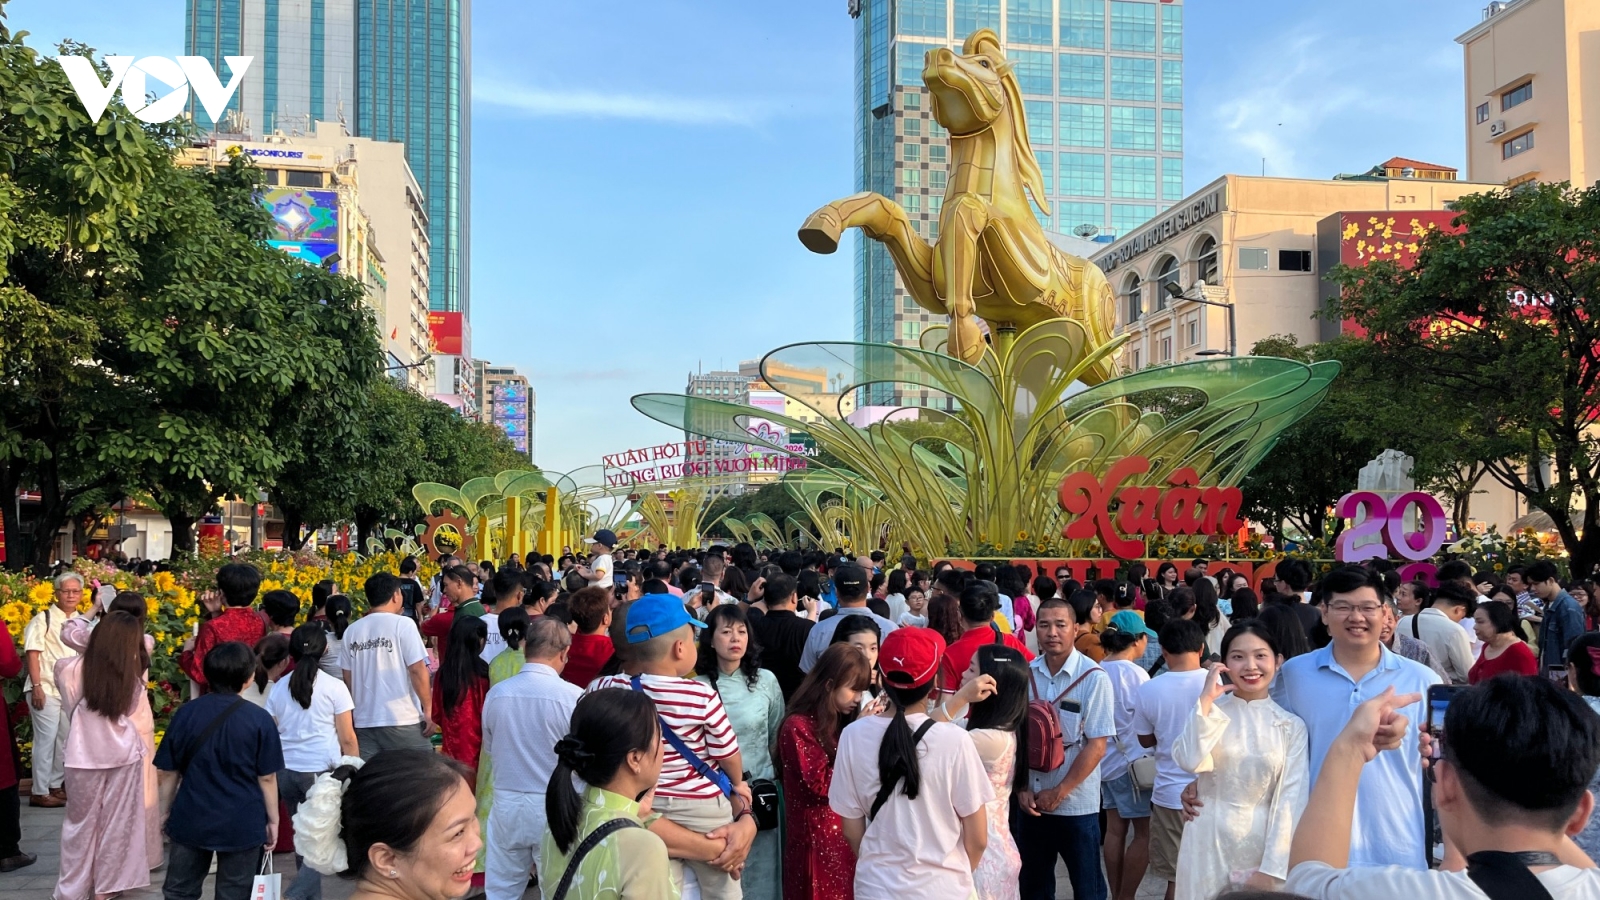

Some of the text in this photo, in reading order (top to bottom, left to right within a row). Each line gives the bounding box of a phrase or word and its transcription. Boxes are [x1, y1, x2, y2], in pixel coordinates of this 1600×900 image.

[1148, 217, 1178, 248] HOTEL
[1176, 193, 1218, 231] SAIGON
[603, 449, 649, 470] XUÂN
[653, 443, 680, 460] HỘI
[1058, 455, 1244, 560] Xuân
